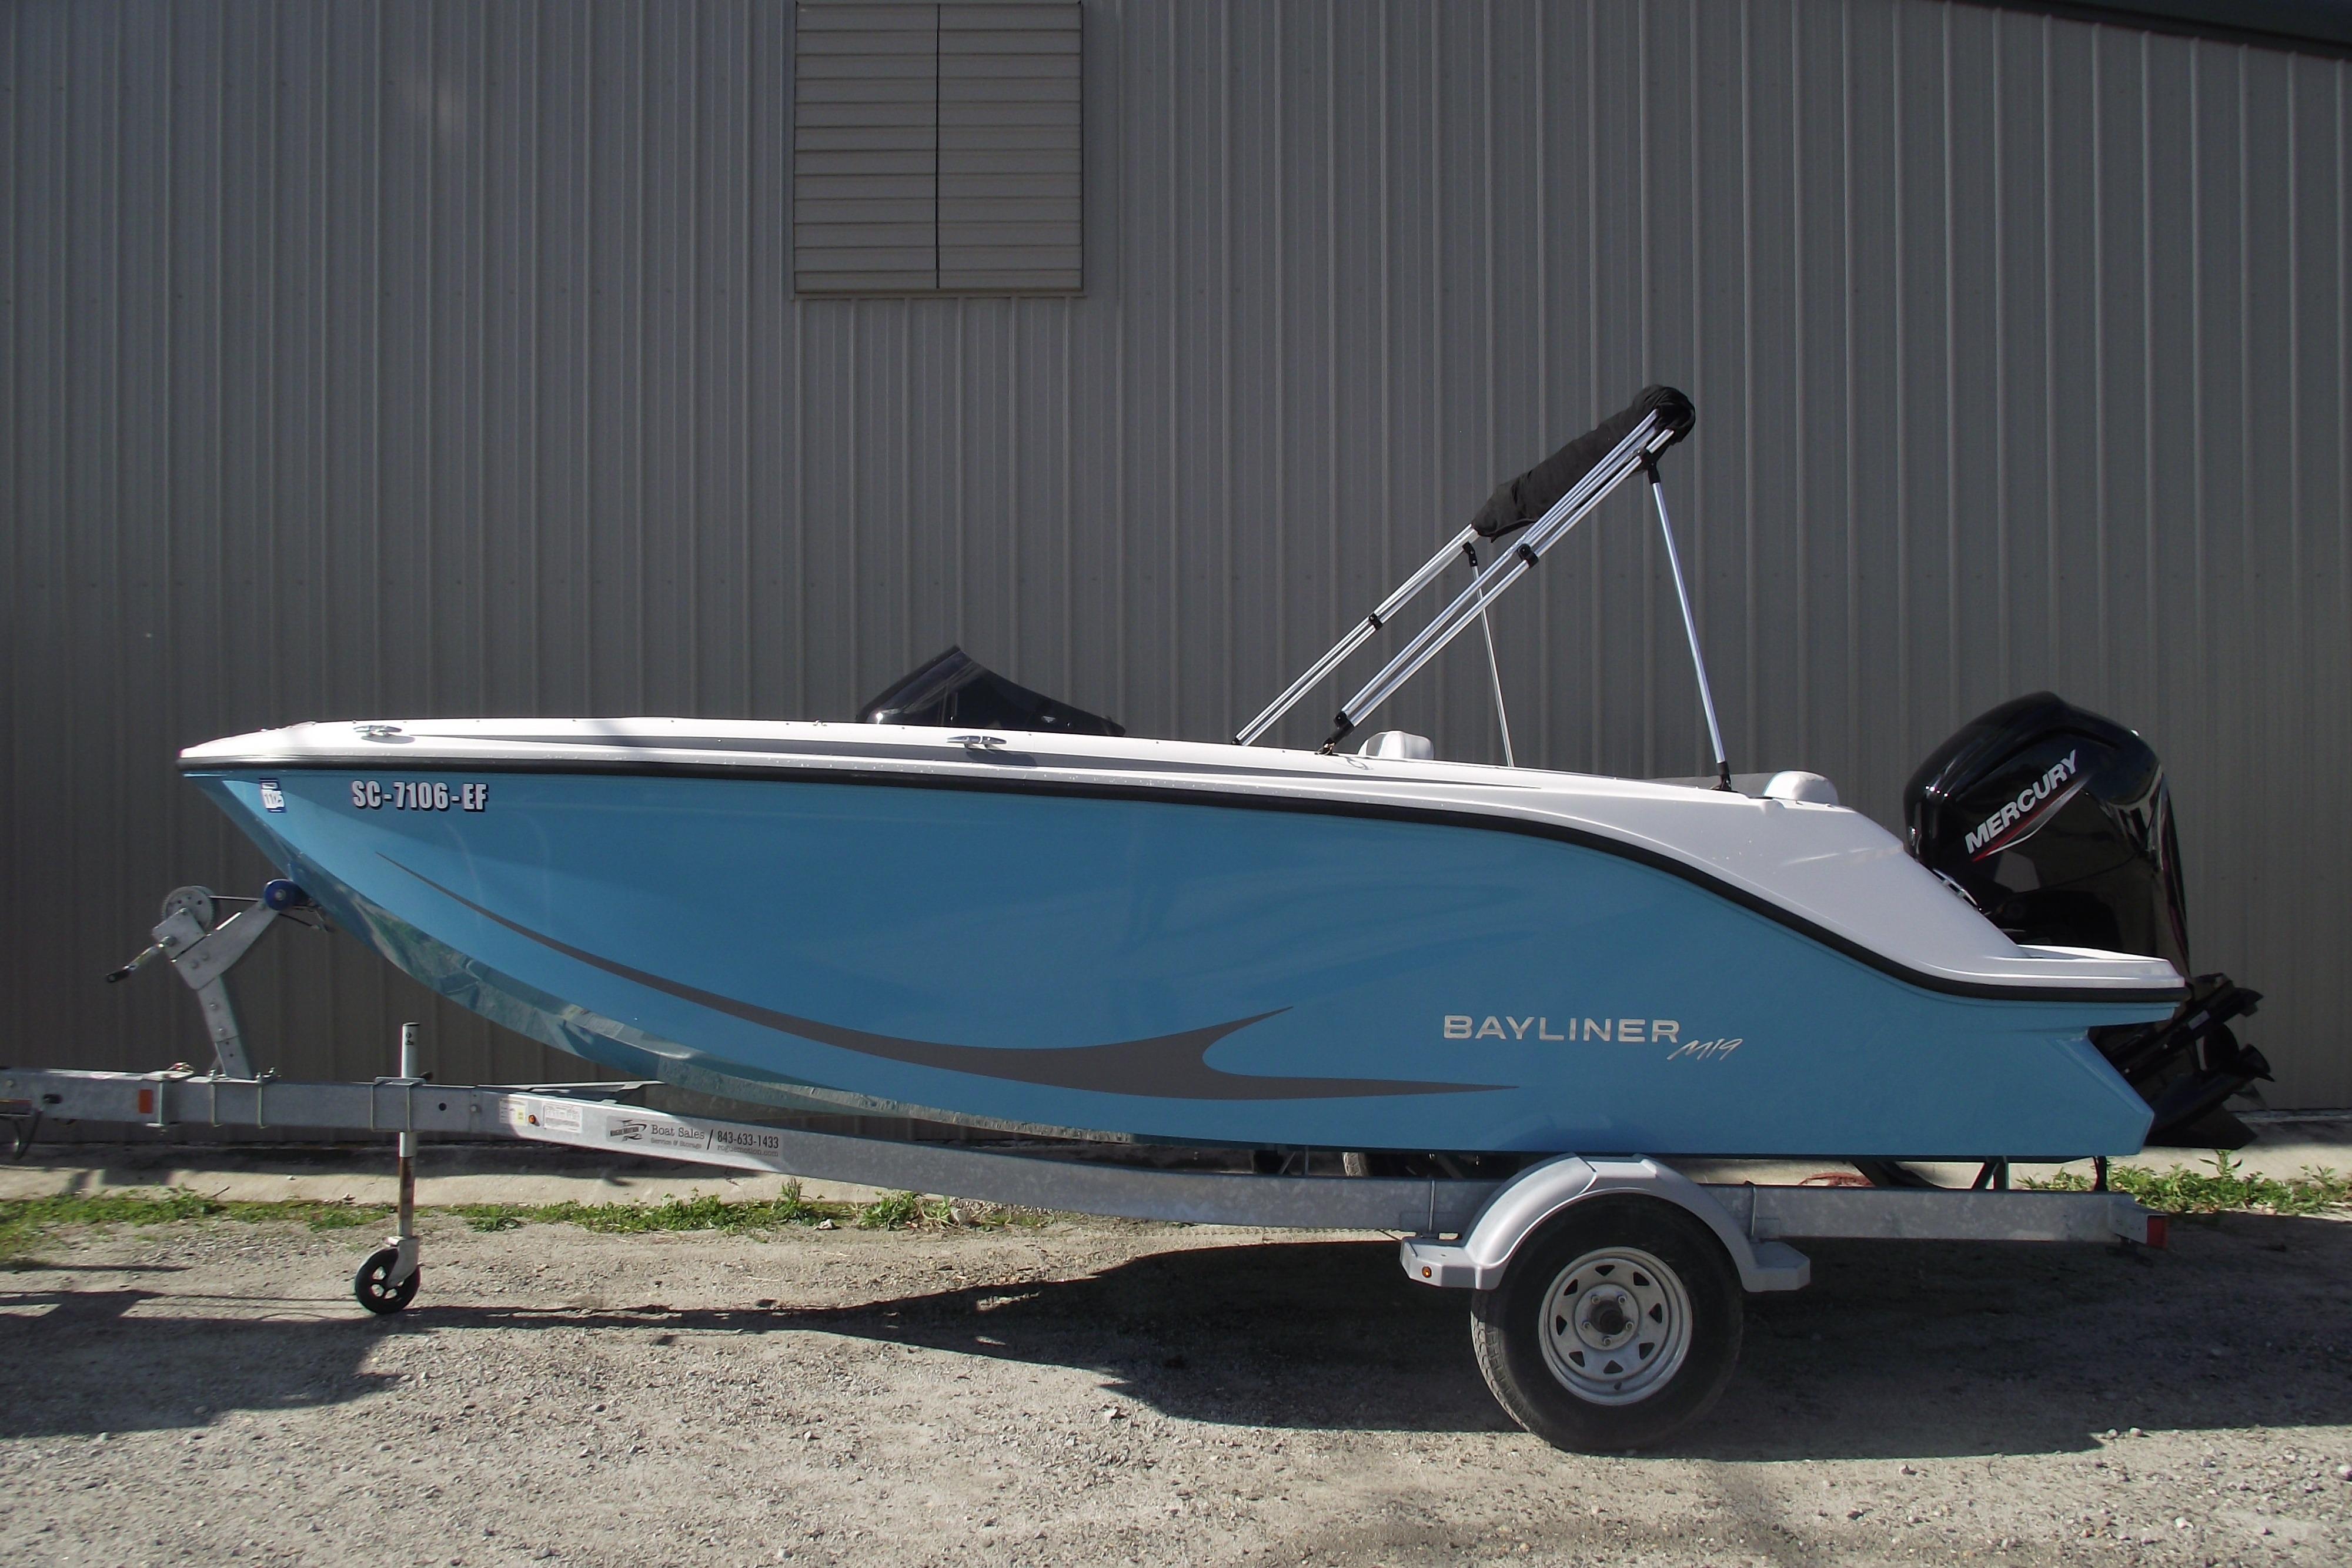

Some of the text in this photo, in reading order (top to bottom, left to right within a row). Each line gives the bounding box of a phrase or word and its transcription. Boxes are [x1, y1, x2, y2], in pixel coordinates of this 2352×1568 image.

[352, 780, 489, 813] SC-7106-EF
[1965, 749, 2078, 855] MERCURY
[1443, 1015, 1680, 1044] BAYLINER
[1666, 1038, 1744, 1061] M19
[651, 1124, 675, 1136] Boat
[678, 1127, 706, 1139] Sales
[717, 1130, 779, 1149] 843-633-1433
[717, 1144, 779, 1157] roguemotion.com
